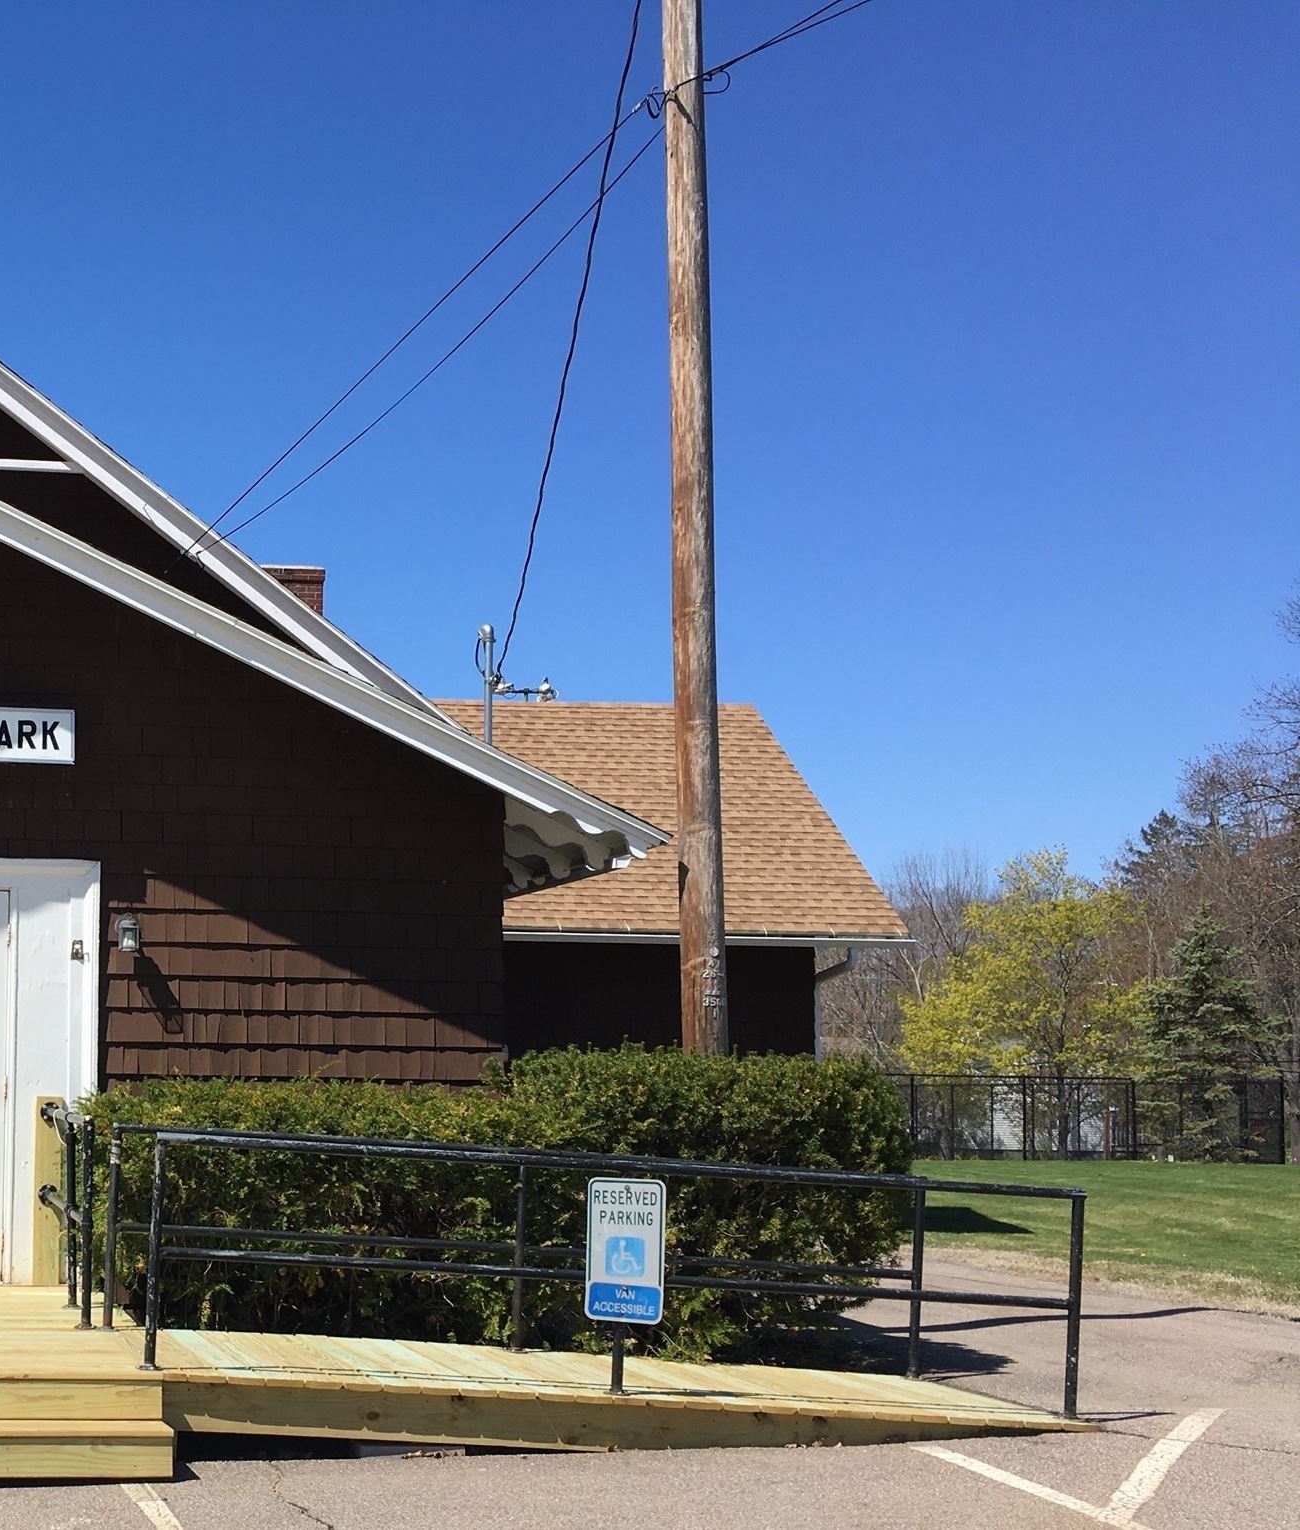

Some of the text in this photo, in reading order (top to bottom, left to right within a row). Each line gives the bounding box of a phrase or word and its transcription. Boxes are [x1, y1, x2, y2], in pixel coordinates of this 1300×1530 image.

[593, 1189, 658, 1206] RESERVED
[599, 1210, 654, 1226] PARKING
[615, 1288, 636, 1300] VAN
[592, 1301, 656, 1316] ACCESSIBLE
